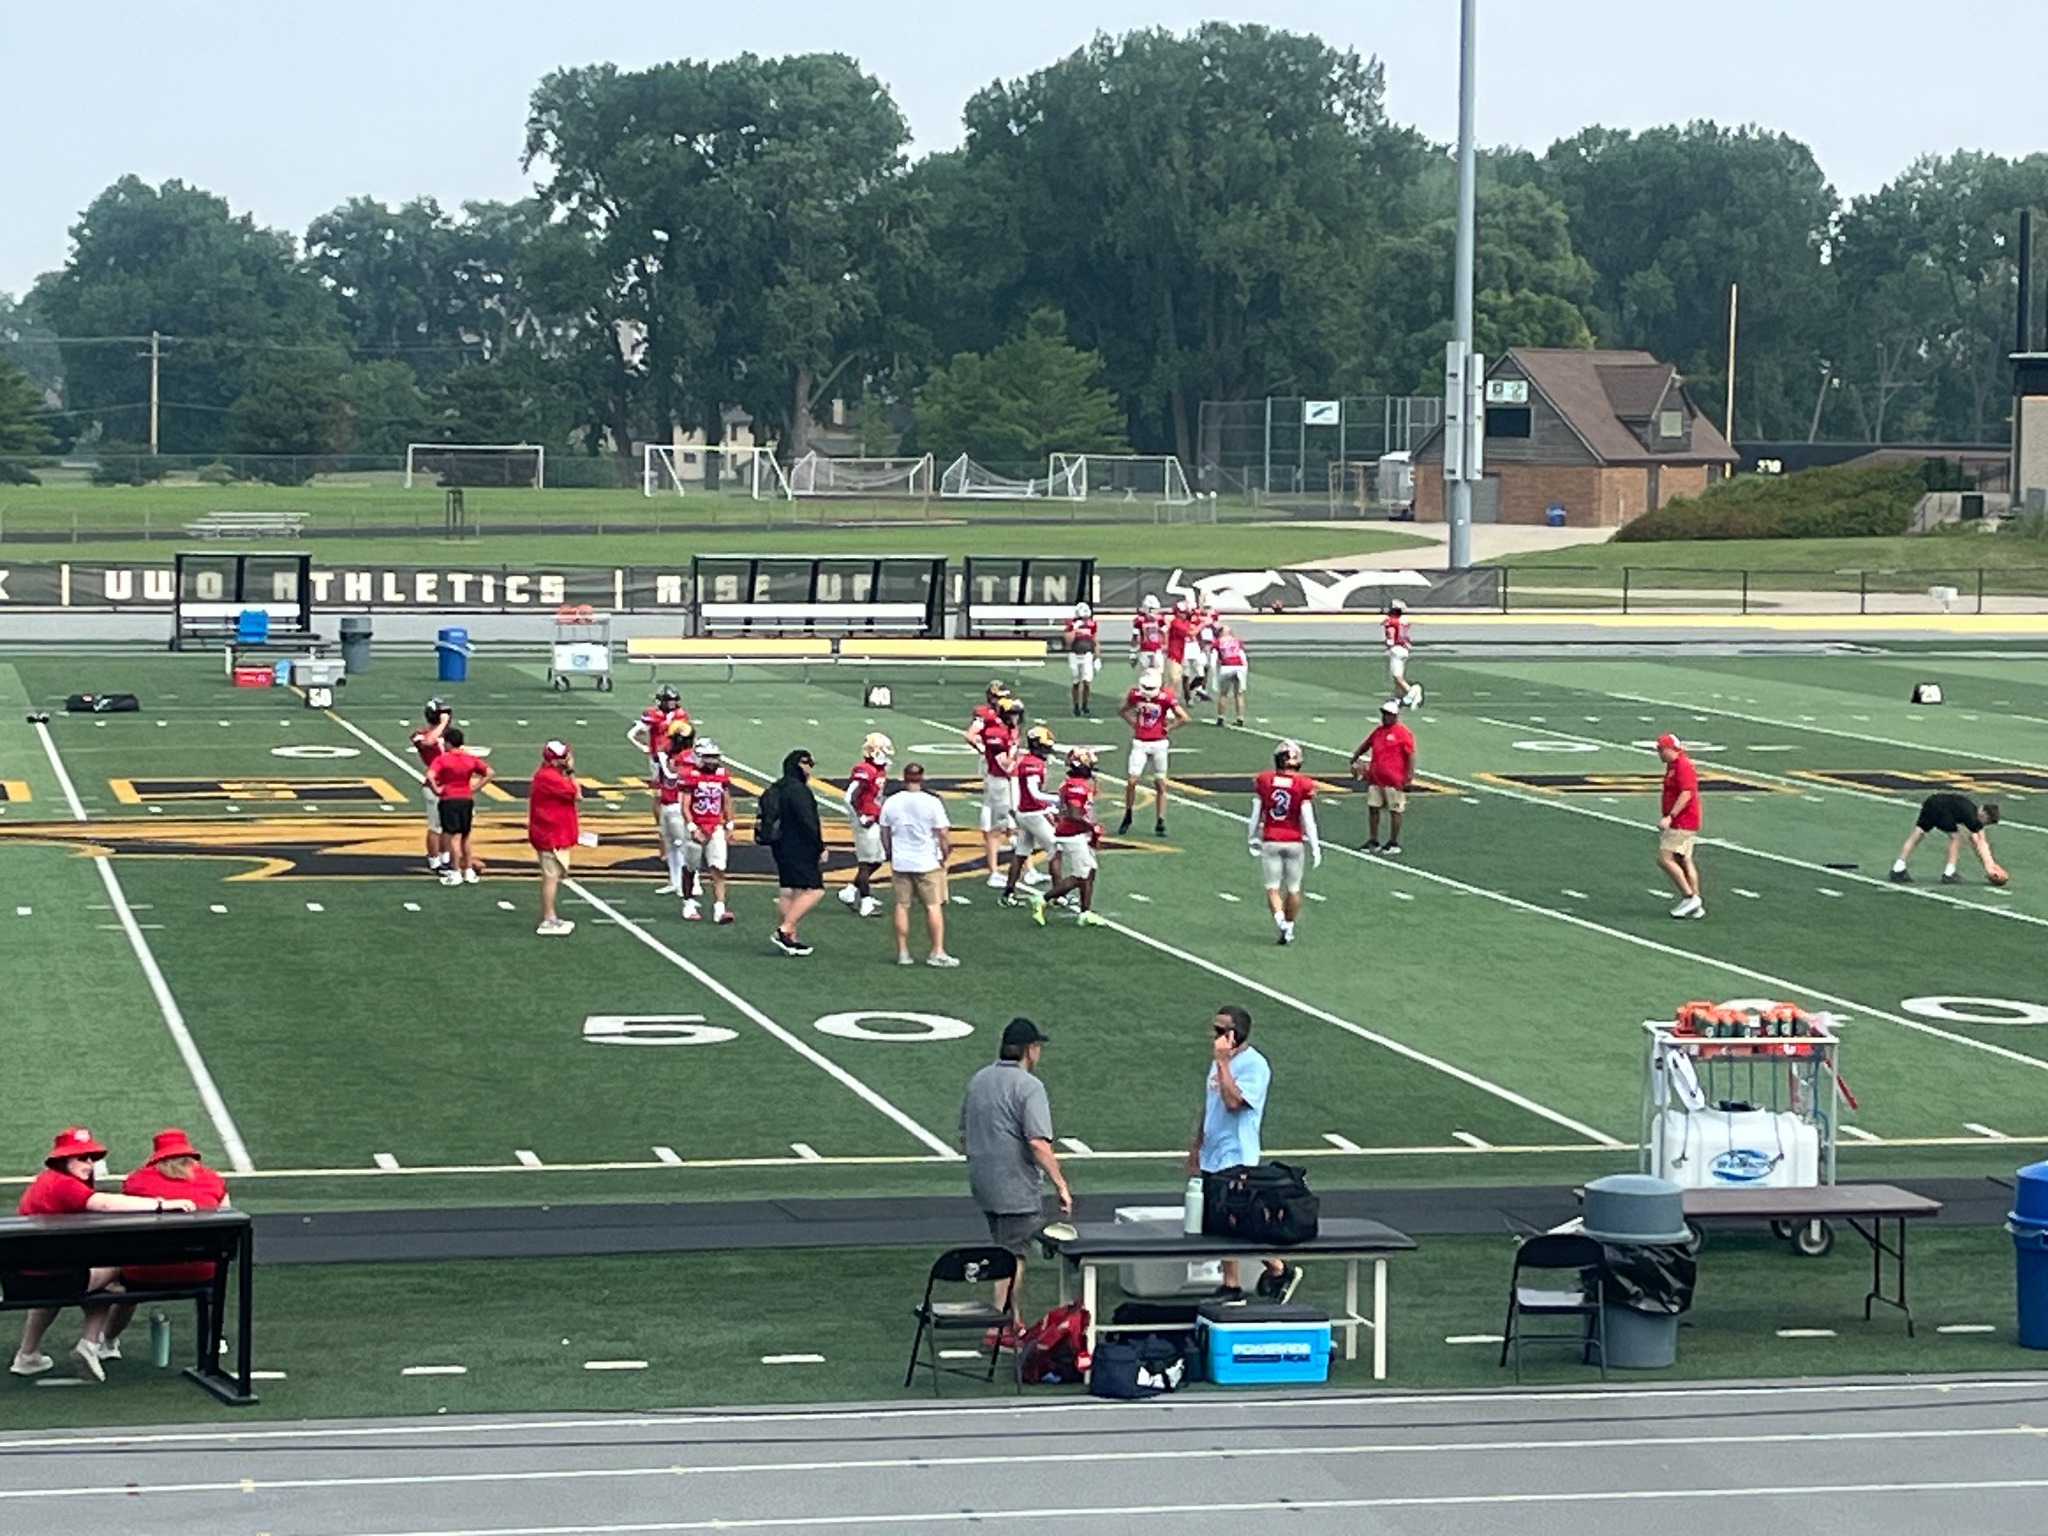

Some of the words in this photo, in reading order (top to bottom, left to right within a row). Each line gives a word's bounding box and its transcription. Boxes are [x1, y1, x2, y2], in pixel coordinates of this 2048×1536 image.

[105, 570, 223, 600] UWO
[273, 571, 565, 604] ATHLETICS
[309, 687, 333, 707] 50
[582, 1012, 975, 1047] 50
